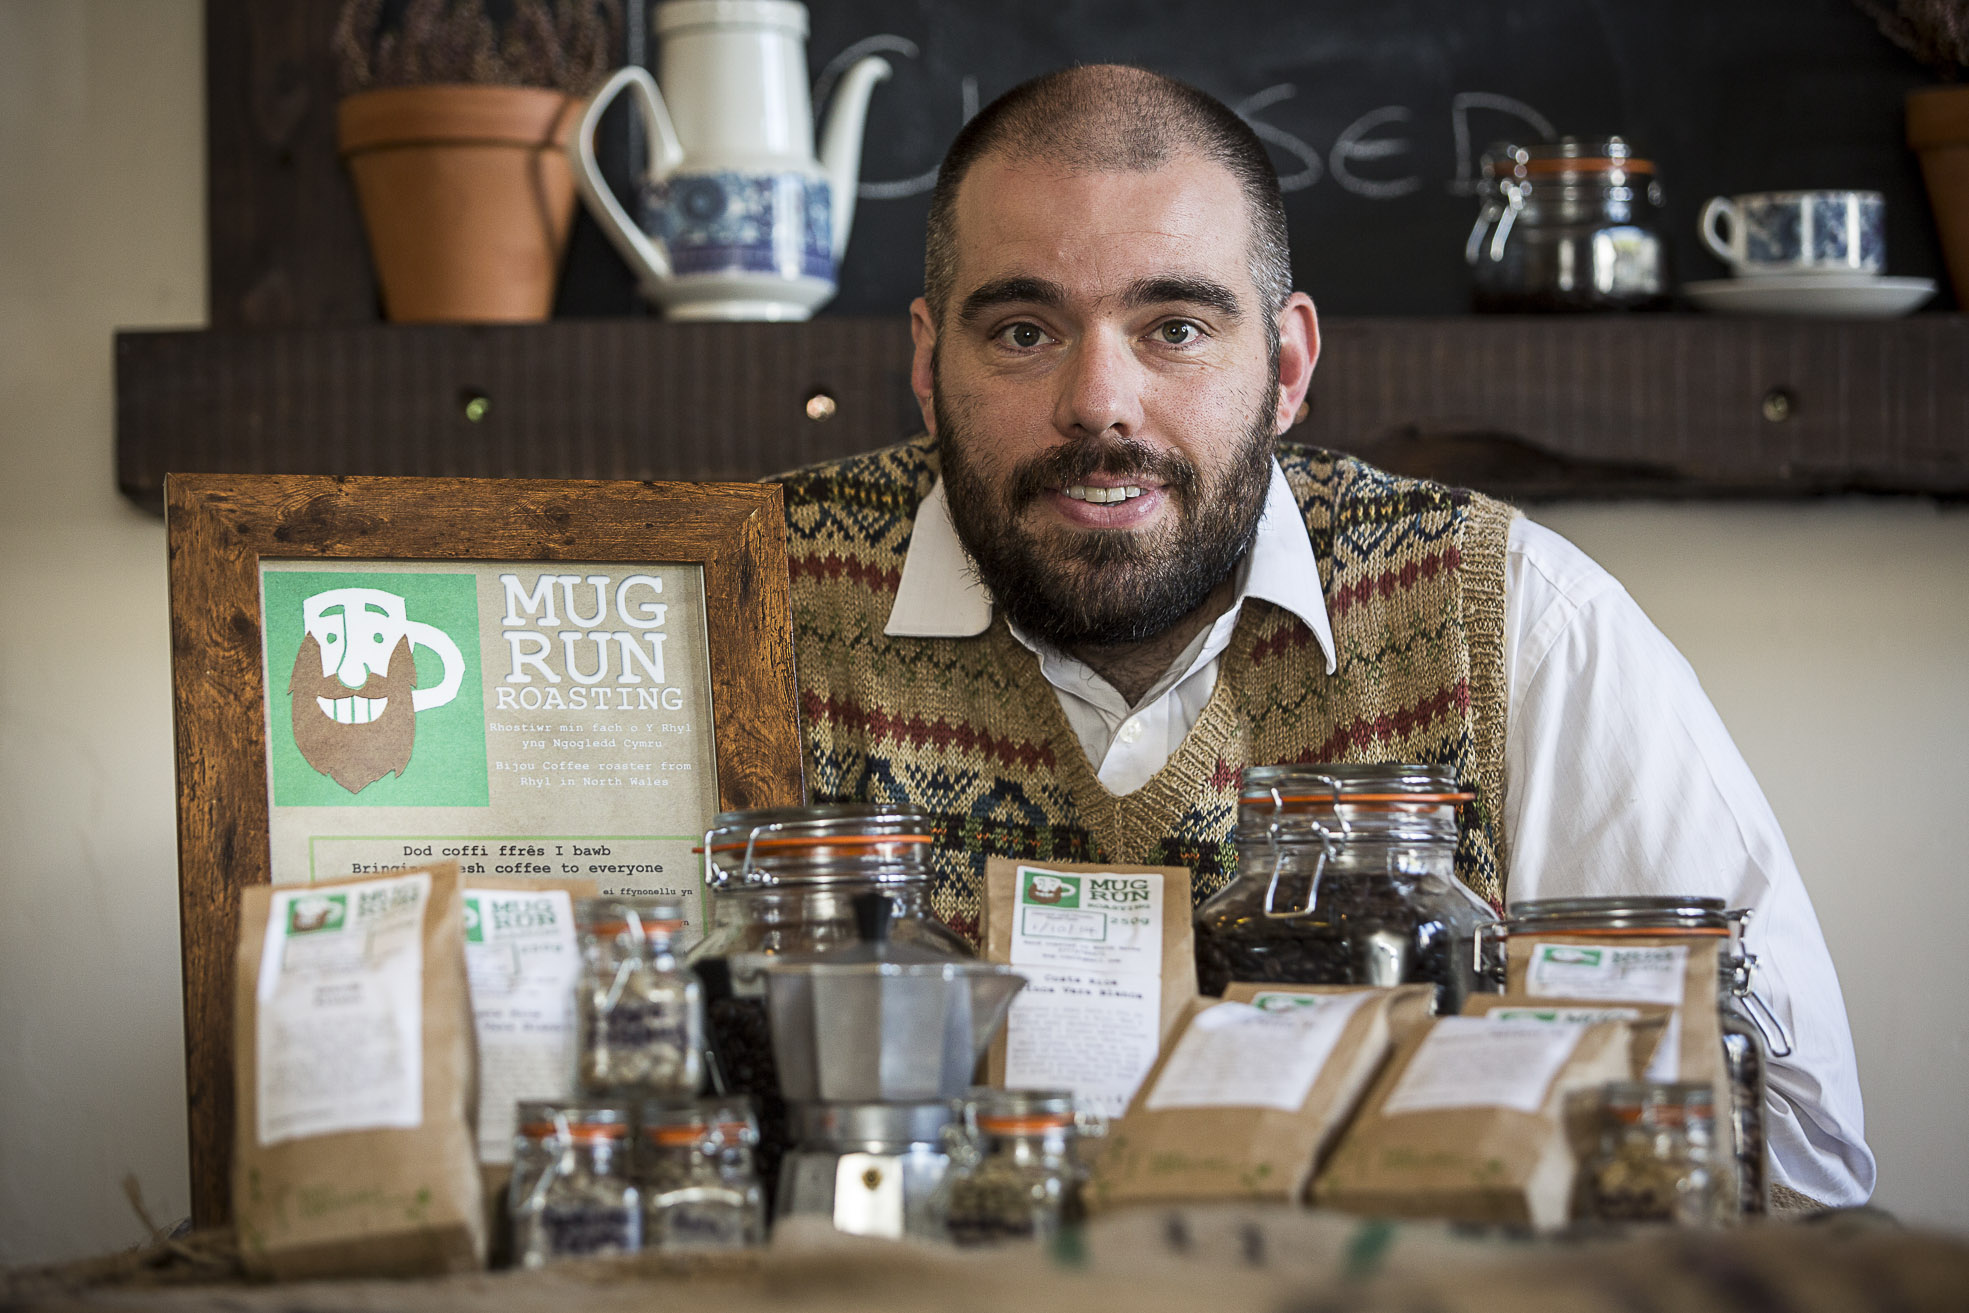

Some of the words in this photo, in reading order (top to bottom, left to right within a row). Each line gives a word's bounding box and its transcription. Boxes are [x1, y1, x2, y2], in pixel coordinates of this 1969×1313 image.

[499, 573, 669, 629] MUG
[502, 630, 668, 685] RUN
[495, 686, 684, 711] ROASTING
[489, 723, 552, 733] Rhostiwr
[559, 723, 584, 733] min
[592, 723, 623, 733] fach
[630, 724, 639, 733] o
[646, 723, 654, 733] Y
[662, 723, 693, 734] Rhyl
[522, 740, 545, 749] yng
[553, 738, 616, 749] Ngogledd
[624, 739, 663, 749] Cymru
[495, 761, 535, 772] Bijou
[543, 761, 590, 771] Coffee
[599, 762, 652, 771] roaster
[660, 761, 692, 771] from
[520, 777, 552, 788] Rhyl
[560, 777, 575, 786] in
[583, 777, 623, 787] North
[630, 777, 669, 787] Wales
[403, 845, 433, 856] Dod
[442, 845, 488, 856] coffi
[499, 844, 545, 856] ffrês
[555, 845, 564, 856] I
[573, 845, 611, 856] bawb
[495, 863, 551, 874] coffee
[562, 863, 579, 873] to
[589, 863, 664, 875] everyone
[1089, 879, 1149, 891] MUG
[620, 888, 676, 897] ffynonellu
[681, 889, 693, 897] yn
[1089, 890, 1150, 902] RUN
